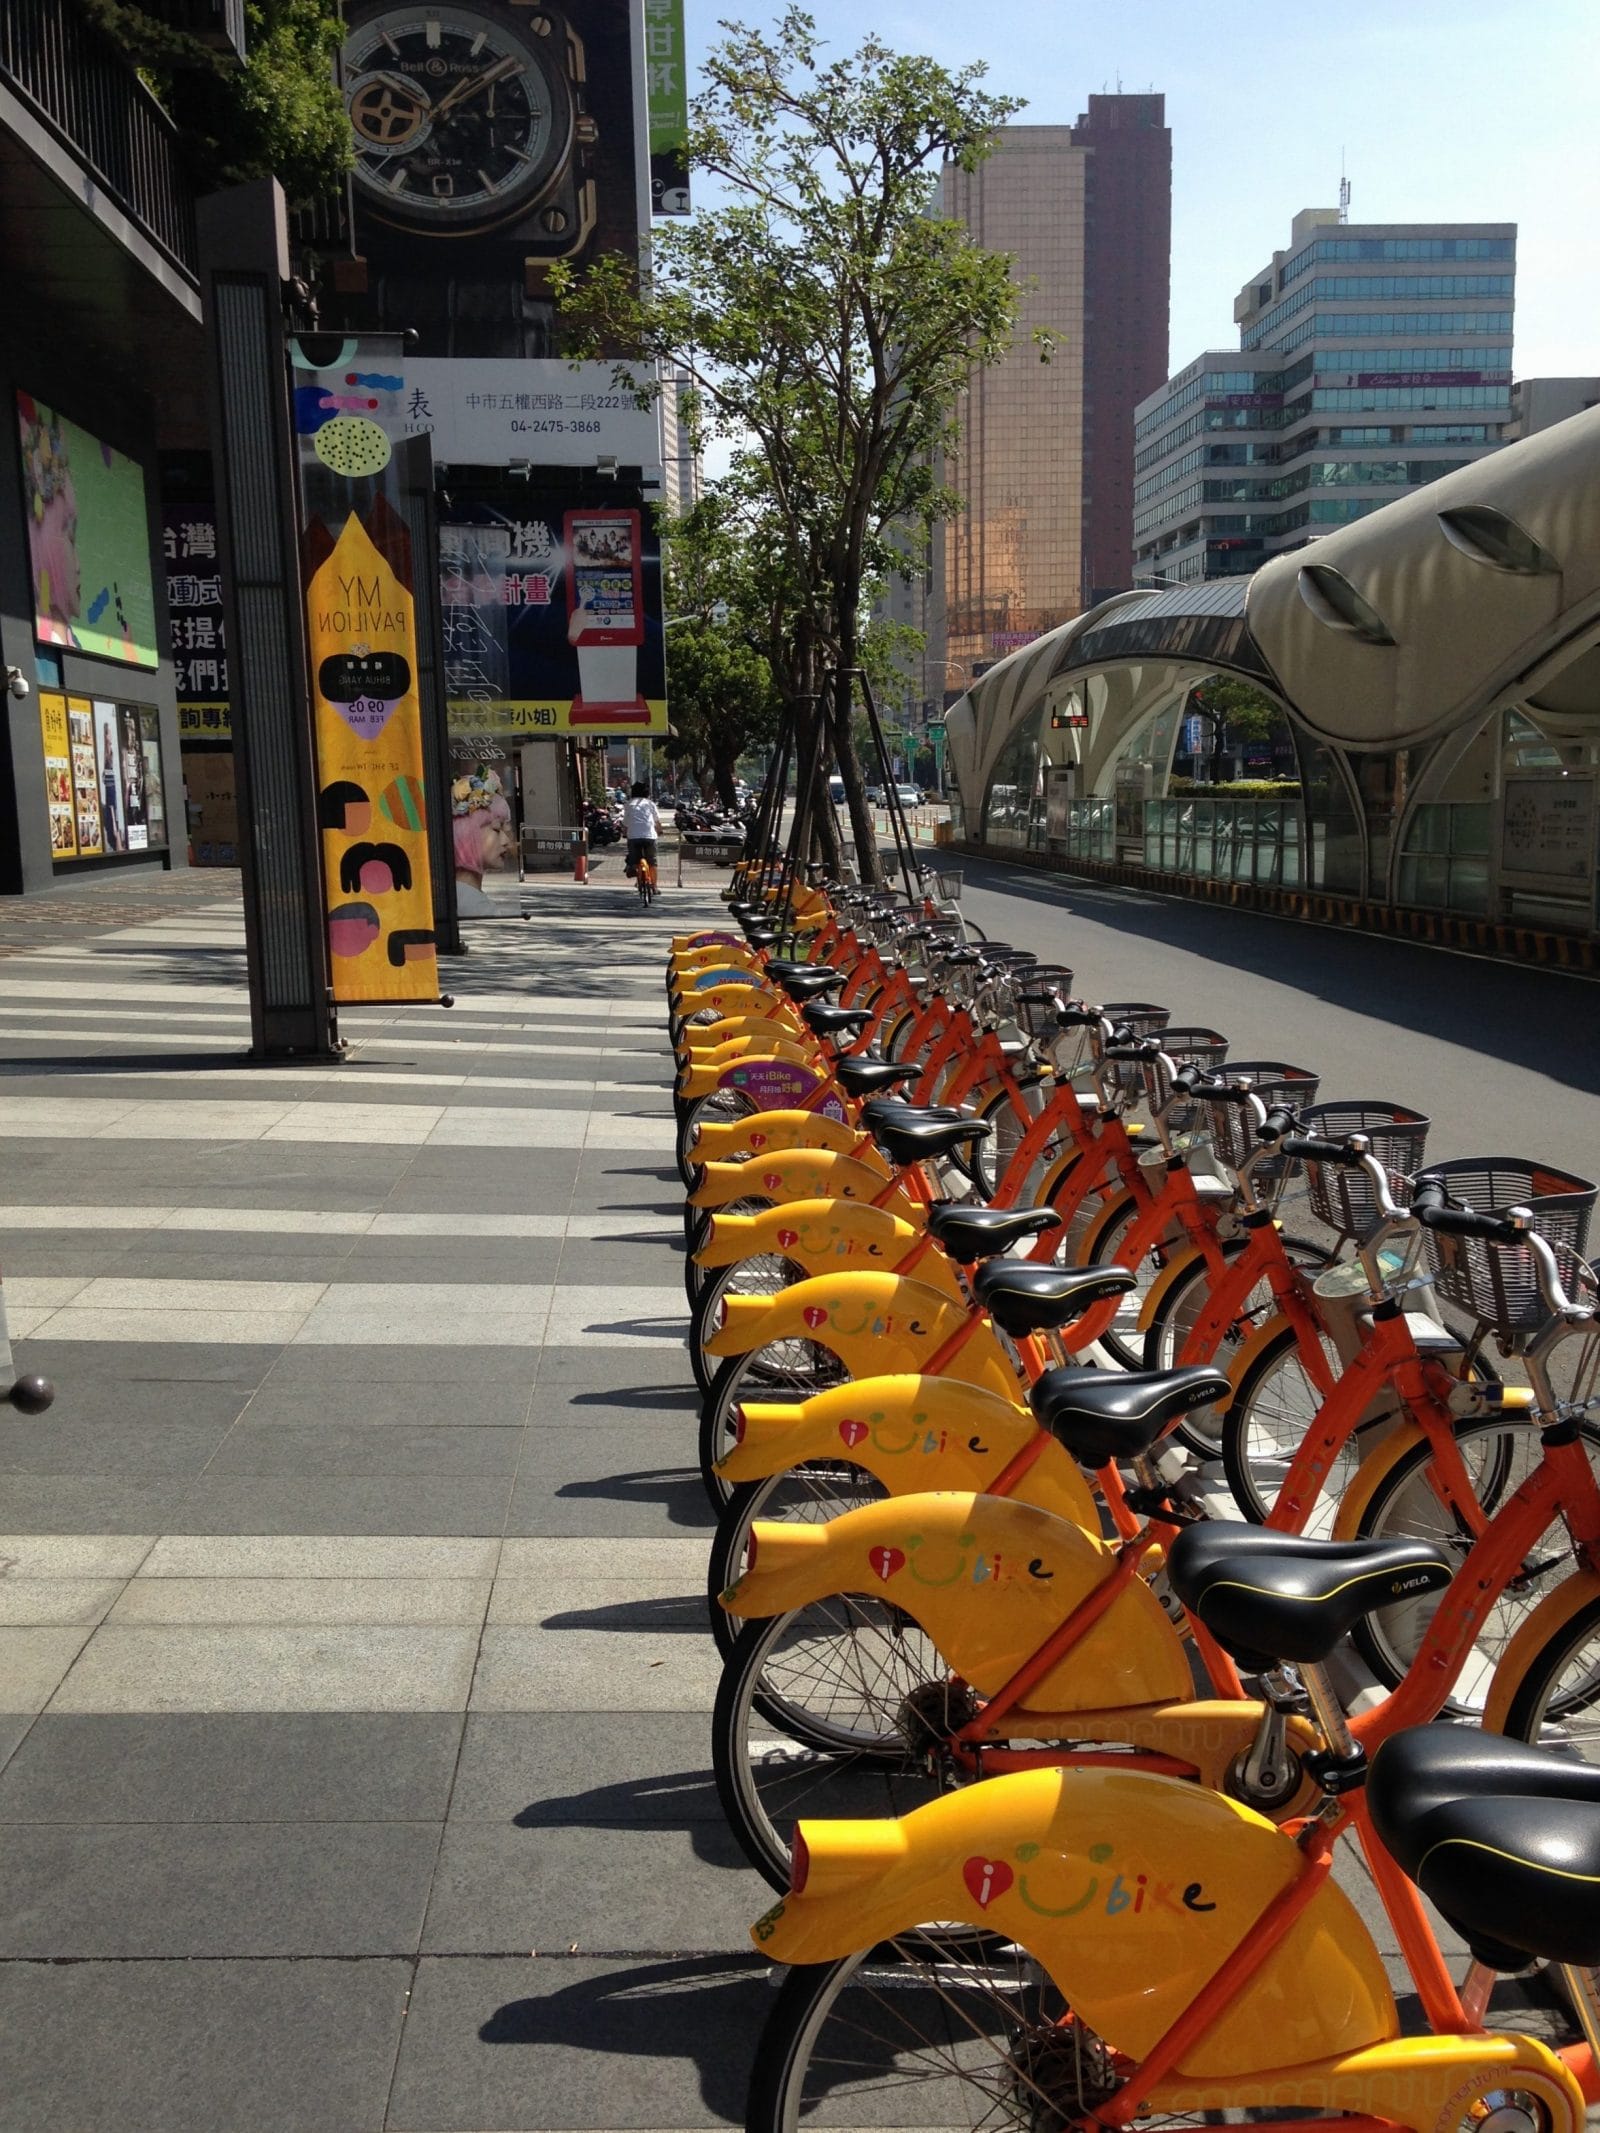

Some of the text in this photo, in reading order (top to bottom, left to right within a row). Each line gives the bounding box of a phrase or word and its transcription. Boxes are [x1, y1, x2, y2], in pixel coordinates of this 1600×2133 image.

[401, 61, 424, 73] Bell
[449, 62, 480, 73] Ross
[407, 388, 433, 419] 表
[511, 420, 601, 433] 04-2475-3868
[1196, 1387, 1216, 1400] VELO
[1402, 1575, 1429, 1590] VELO
[1106, 1874, 1217, 1916] bike
